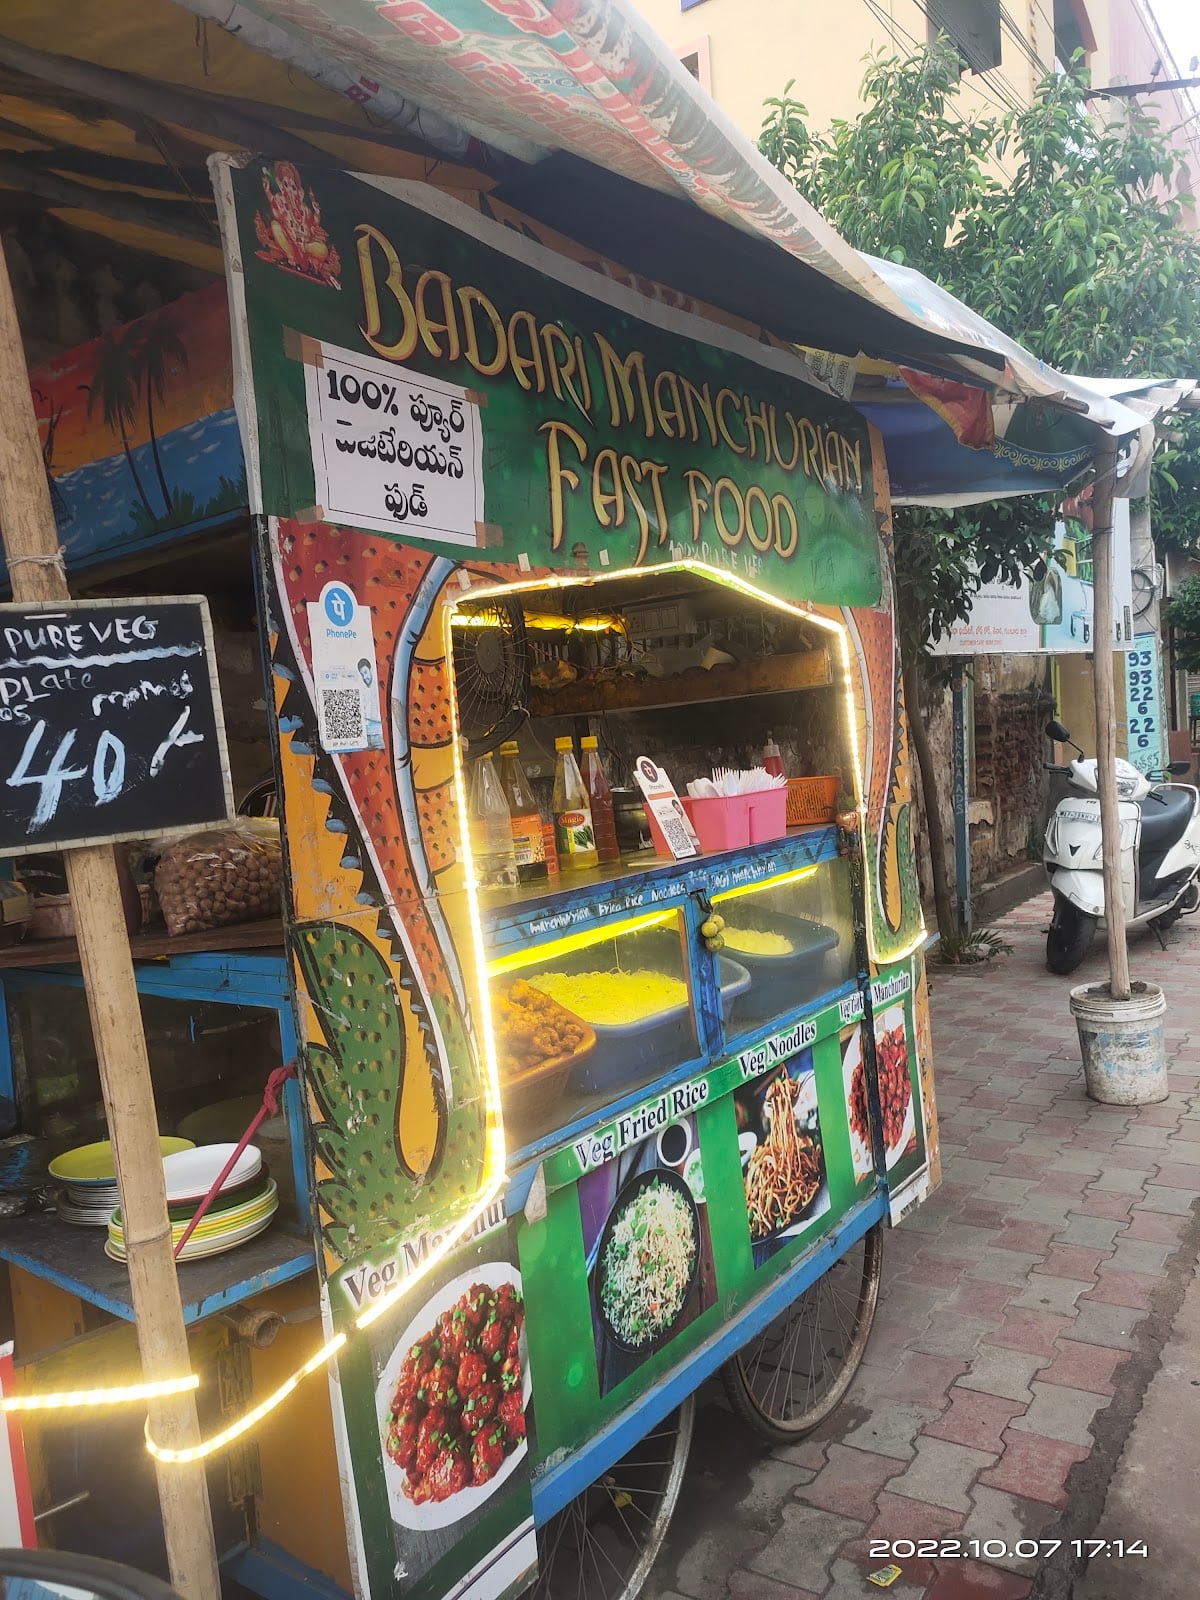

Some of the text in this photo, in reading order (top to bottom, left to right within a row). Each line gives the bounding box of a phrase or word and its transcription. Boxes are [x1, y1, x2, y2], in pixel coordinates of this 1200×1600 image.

[354, 223, 863, 495] BADARI MANCHURIAN
[327, 369, 399, 416] 100%
[538, 421, 798, 567] FAST FOOD
[3, 615, 159, 657] PURE VEG
[326, 628, 357, 639] PhonePe
[1128, 650, 1152, 668] 93
[1129, 669, 1153, 687] 93
[1137, 702, 1149, 715] 6
[1137, 734, 1150, 748] 6
[873, 973, 910, 1005] Manchurian
[738, 1024, 817, 1076] Veg Noodles
[575, 1080, 708, 1169] Veg Fried Rice
[344, 1261, 397, 1308] Veg
